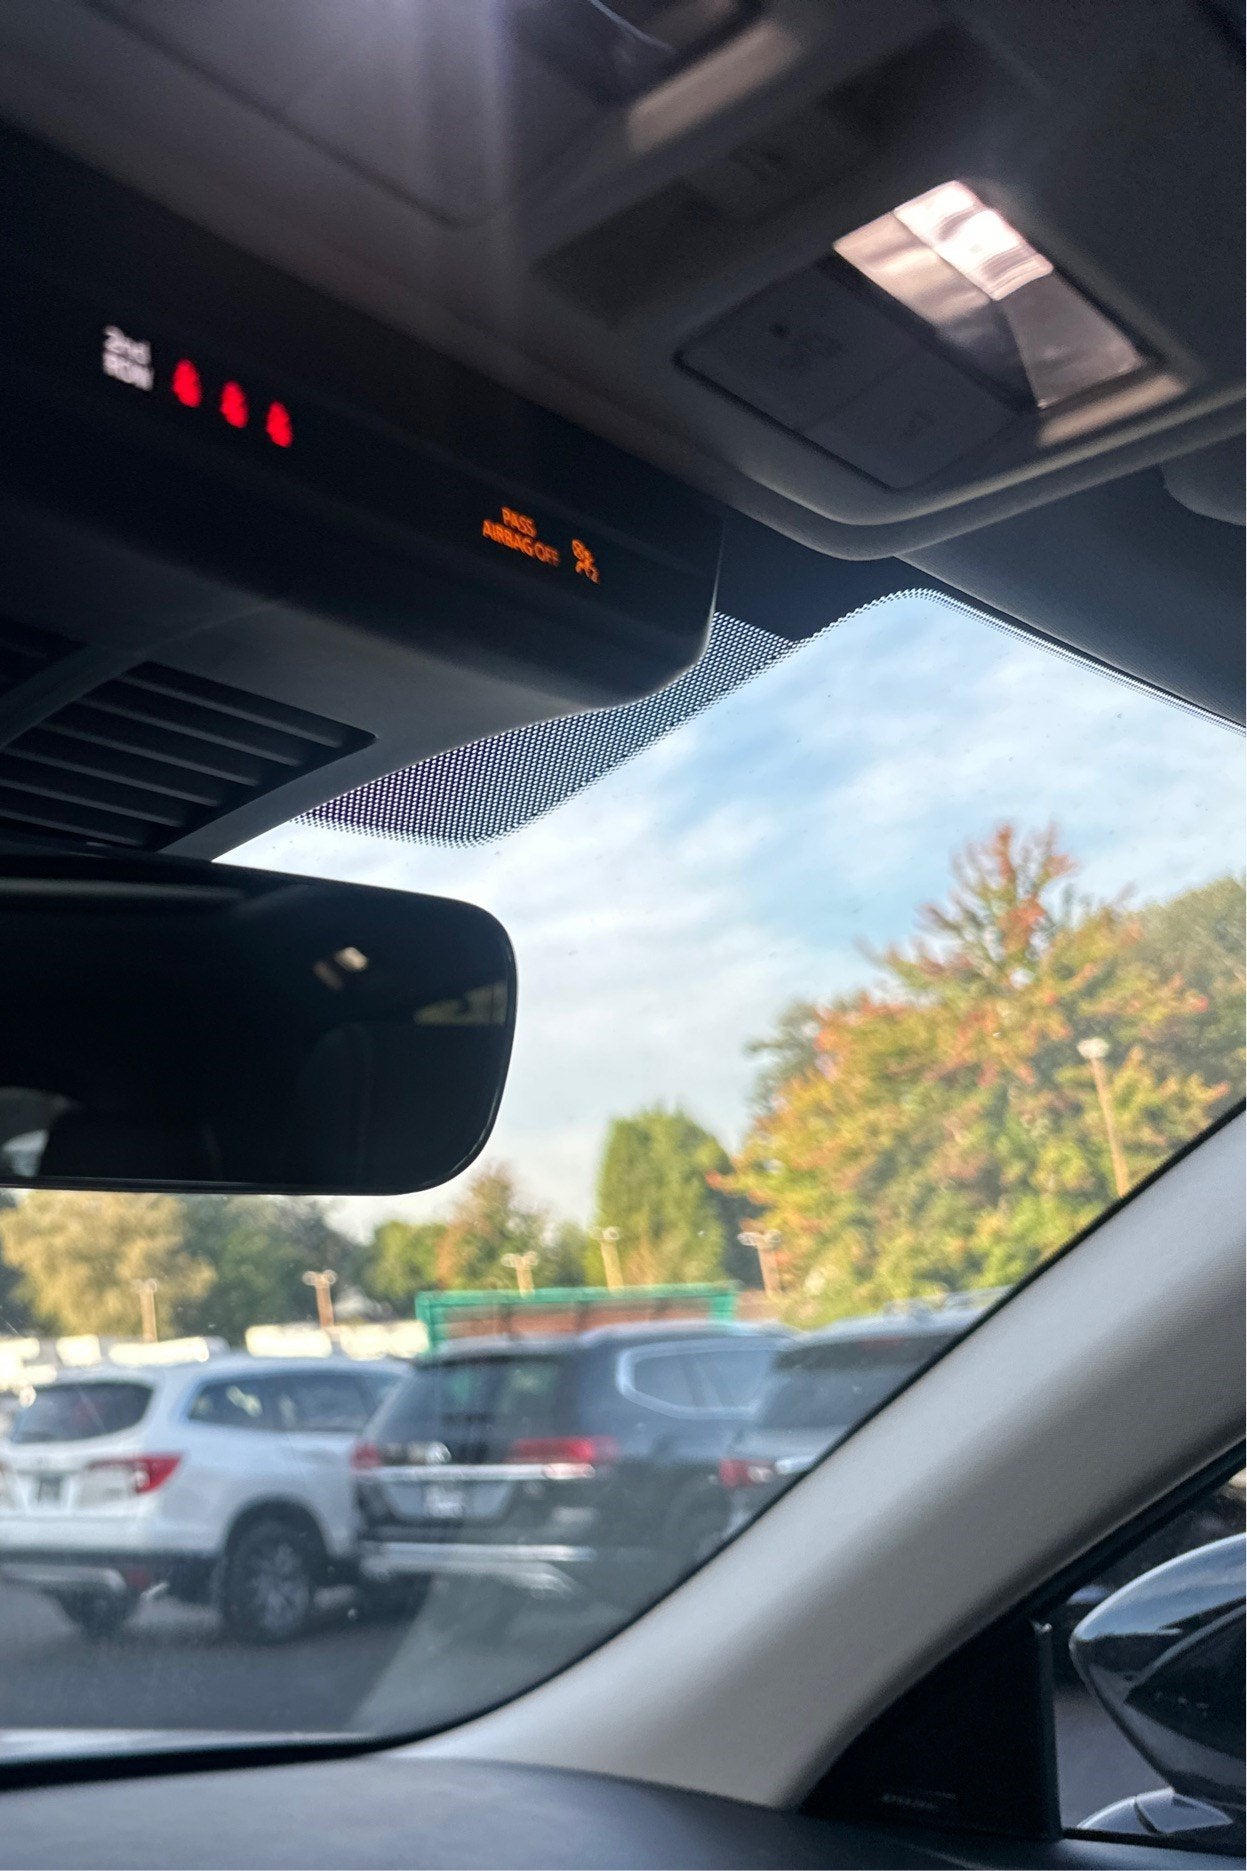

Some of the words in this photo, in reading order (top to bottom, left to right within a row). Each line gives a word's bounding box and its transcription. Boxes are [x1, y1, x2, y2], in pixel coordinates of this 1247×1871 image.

[103, 325, 151, 366] 2nd
[103, 351, 154, 391] ROW
[482, 520, 535, 557] AIRBAG
[502, 506, 537, 537] PASS
